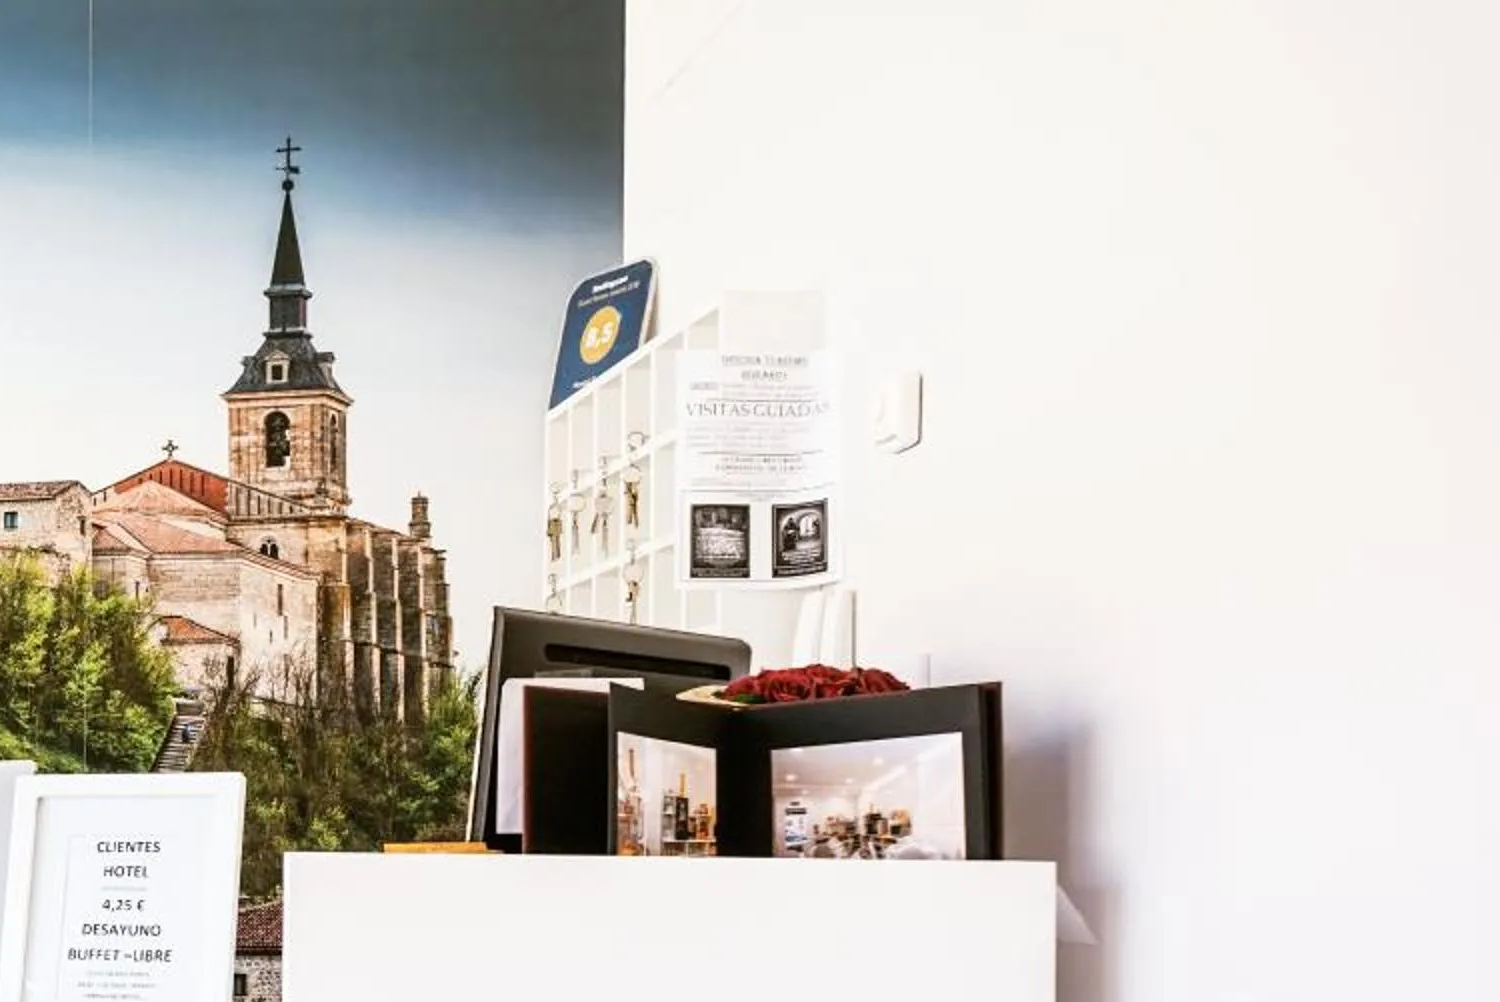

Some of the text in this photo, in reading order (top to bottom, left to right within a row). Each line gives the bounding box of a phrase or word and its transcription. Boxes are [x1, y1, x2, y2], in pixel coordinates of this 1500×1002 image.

[686, 402, 750, 417] VISITAS
[96, 841, 161, 853] CLIENTES
[103, 866, 149, 878] HOTEL
[102, 899, 146, 912] 4,25 €
[81, 923, 162, 937] DESAYUNO
[67, 947, 120, 961] BUFFET
